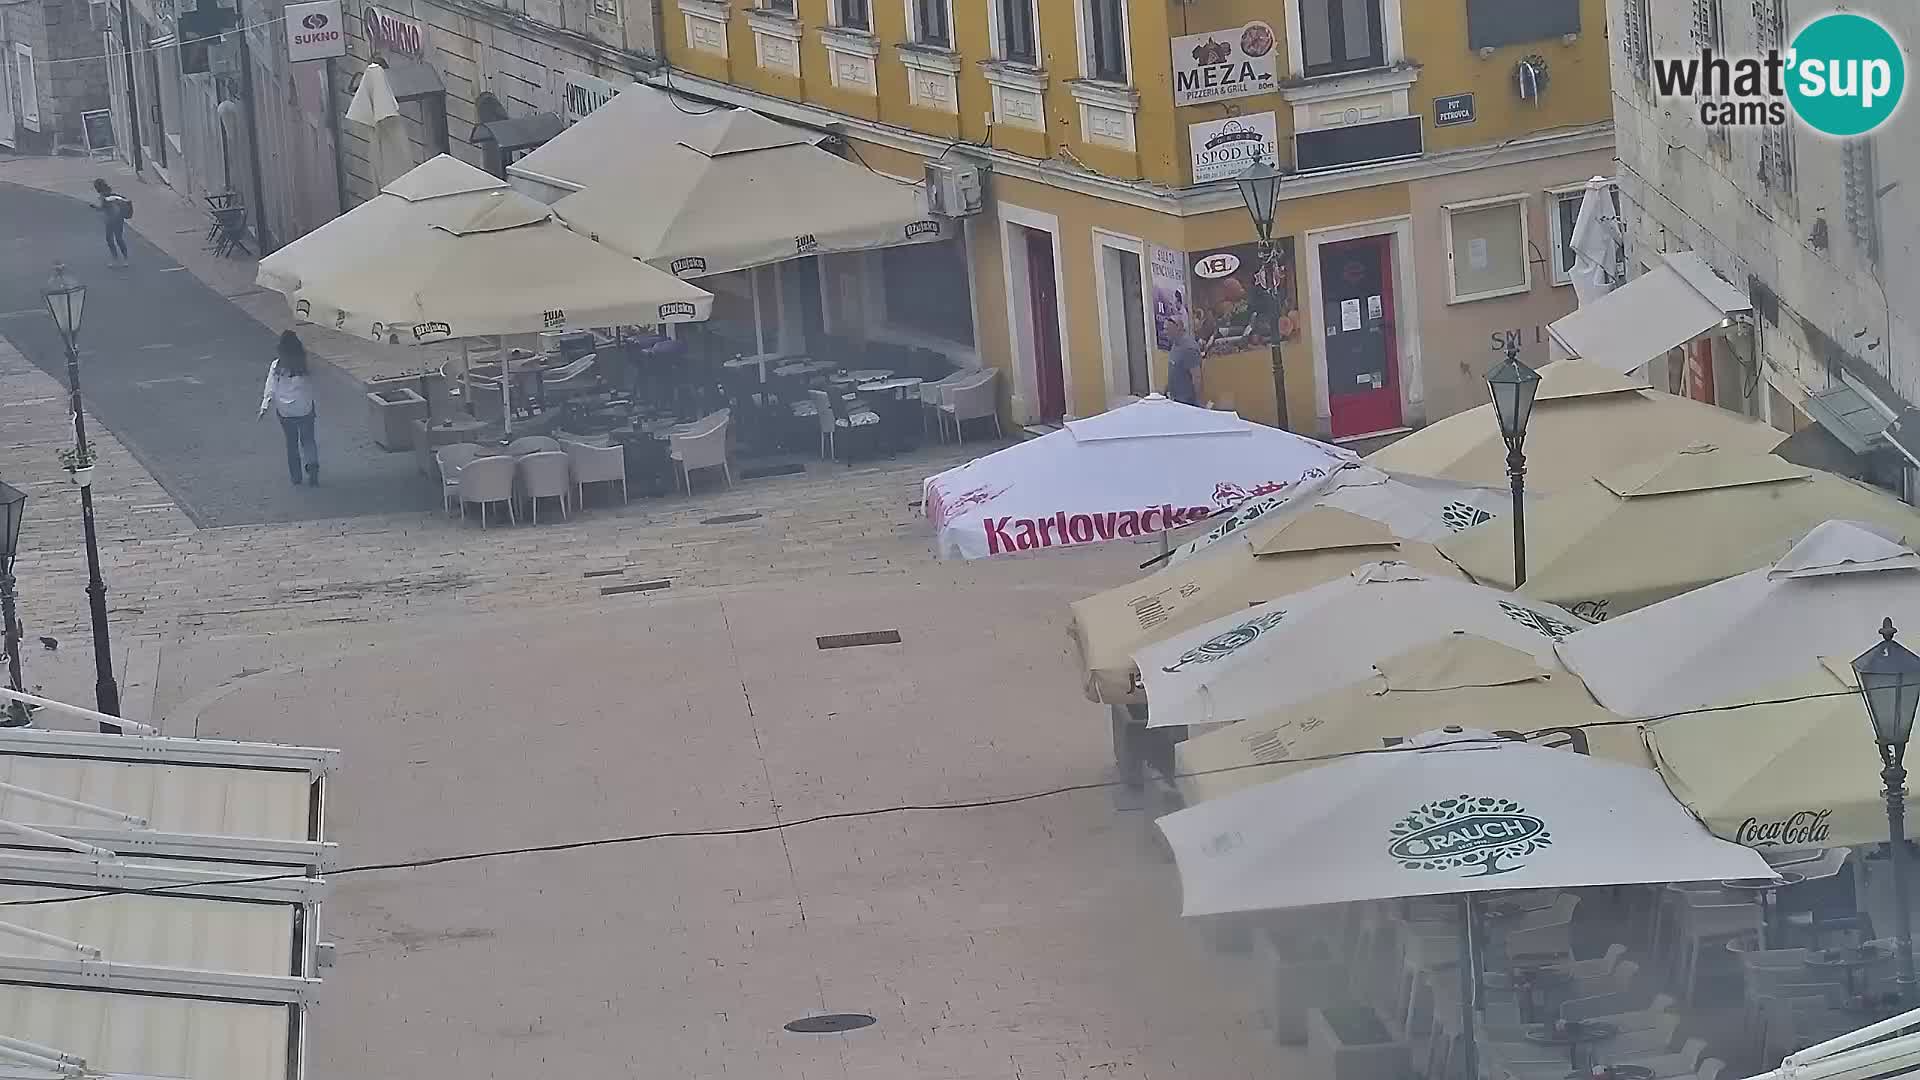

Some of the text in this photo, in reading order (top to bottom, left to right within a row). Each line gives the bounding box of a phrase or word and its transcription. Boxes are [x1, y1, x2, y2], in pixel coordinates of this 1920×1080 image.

[295, 31, 339, 45] SUKNO
[381, 15, 420, 54] SUKNO
[1177, 61, 1257, 92] MEZA
[1186, 83, 1248, 100] PIZZERIA & GRILL
[1440, 109, 1470, 121] PETROVCA
[1196, 147, 1241, 165] ISPOD
[543, 309, 565, 322] ŽUJA
[1428, 819, 1527, 850] RAUCH
